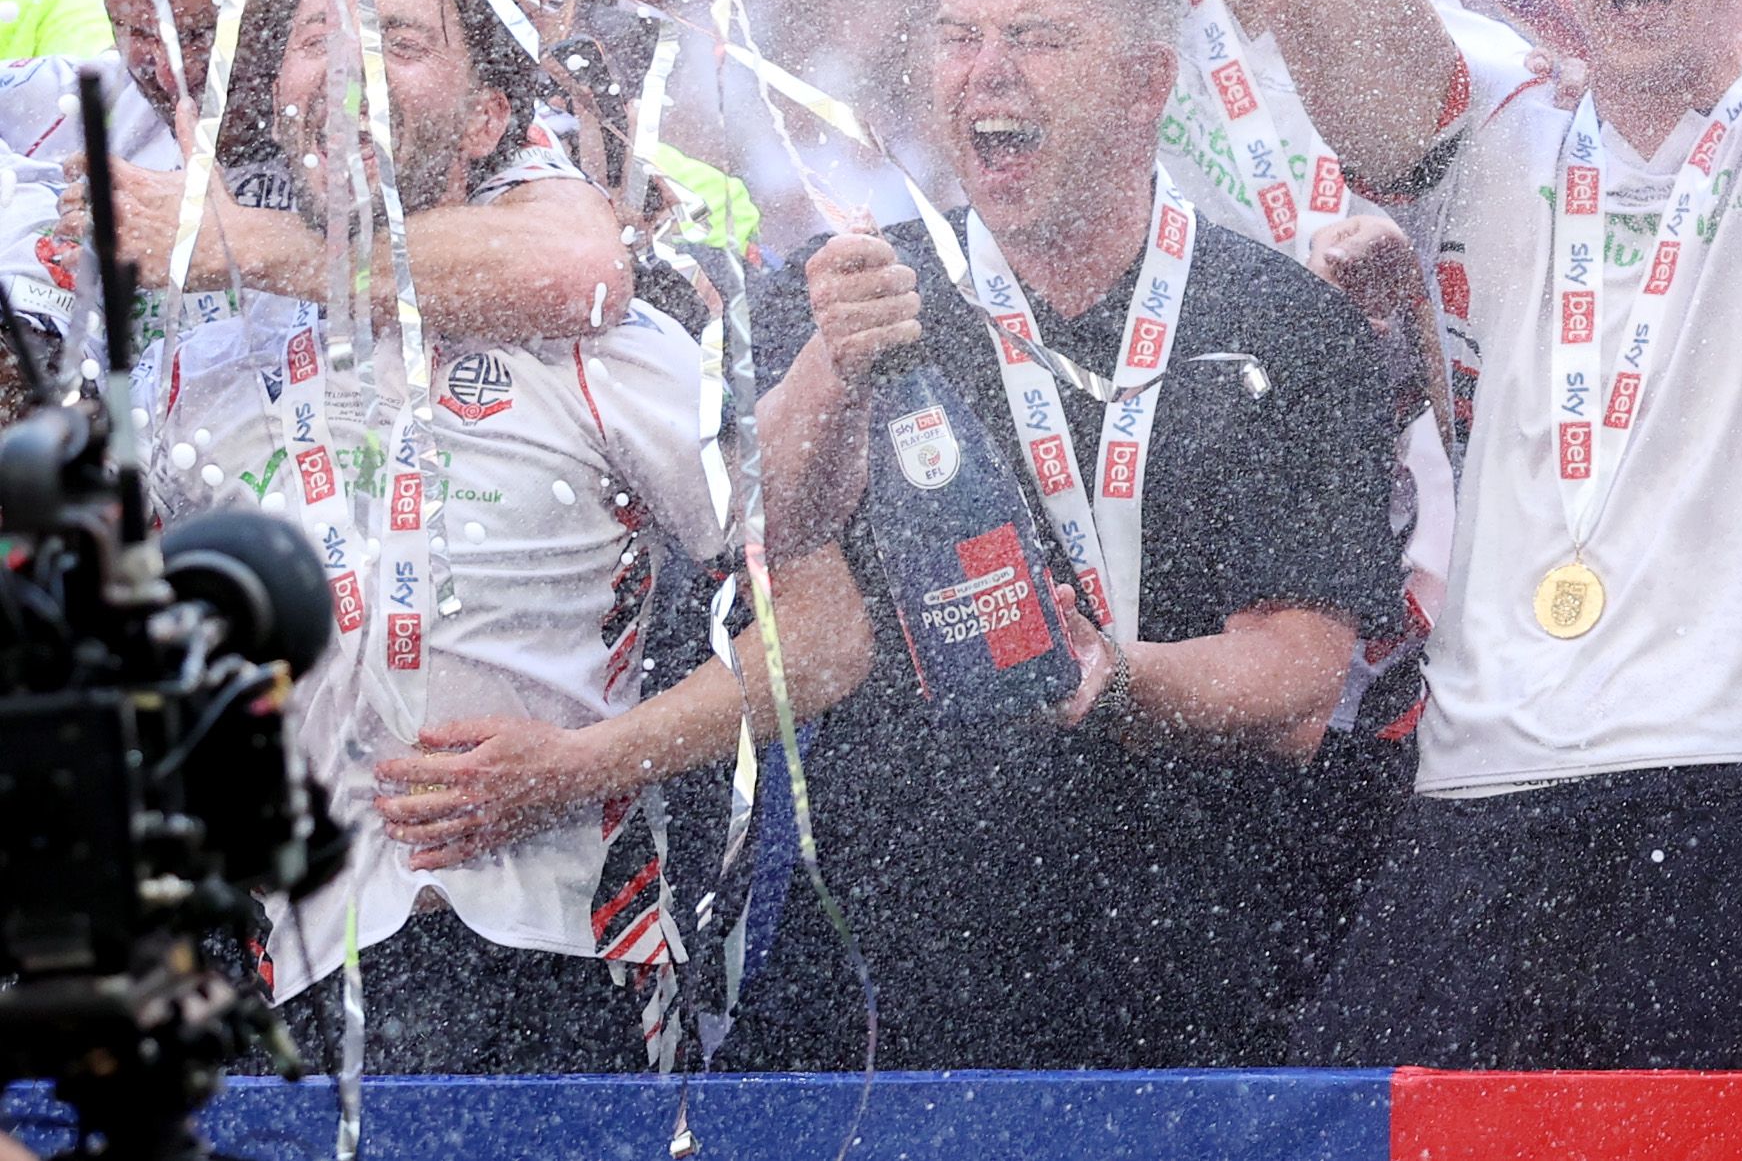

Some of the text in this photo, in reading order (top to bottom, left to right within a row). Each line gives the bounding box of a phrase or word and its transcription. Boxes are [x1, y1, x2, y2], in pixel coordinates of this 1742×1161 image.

[1203, 21, 1297, 239] sky bet sky bet
[1317, 160, 1342, 210] bet
[1158, 207, 1187, 256] bet
[1665, 193, 1692, 236] sky
[986, 275, 1015, 310] sky
[1648, 244, 1677, 294] bet
[28, 283, 76, 313] whit
[1140, 279, 1168, 319] sky
[1560, 132, 1599, 476] sky bet sky bet sky bet
[291, 332, 314, 381] bet
[1132, 322, 1163, 367] bet
[1624, 323, 1649, 368] sky
[292, 402, 316, 443] sky
[1023, 388, 1052, 432] sky
[1610, 375, 1641, 427] bet
[895, 422, 915, 438] sky
[301, 451, 331, 501] bet
[925, 466, 946, 480] EFL
[1037, 440, 1070, 490] bet
[1109, 446, 1137, 494] bet
[396, 478, 422, 527] bet
[322, 527, 347, 570] sky
[1062, 520, 1087, 565] sky
[332, 574, 361, 628] bet
[390, 562, 419, 609] sky
[921, 580, 1030, 630] PROMOTED
[390, 618, 416, 666] bet
[942, 603, 1022, 645] 2025/26
